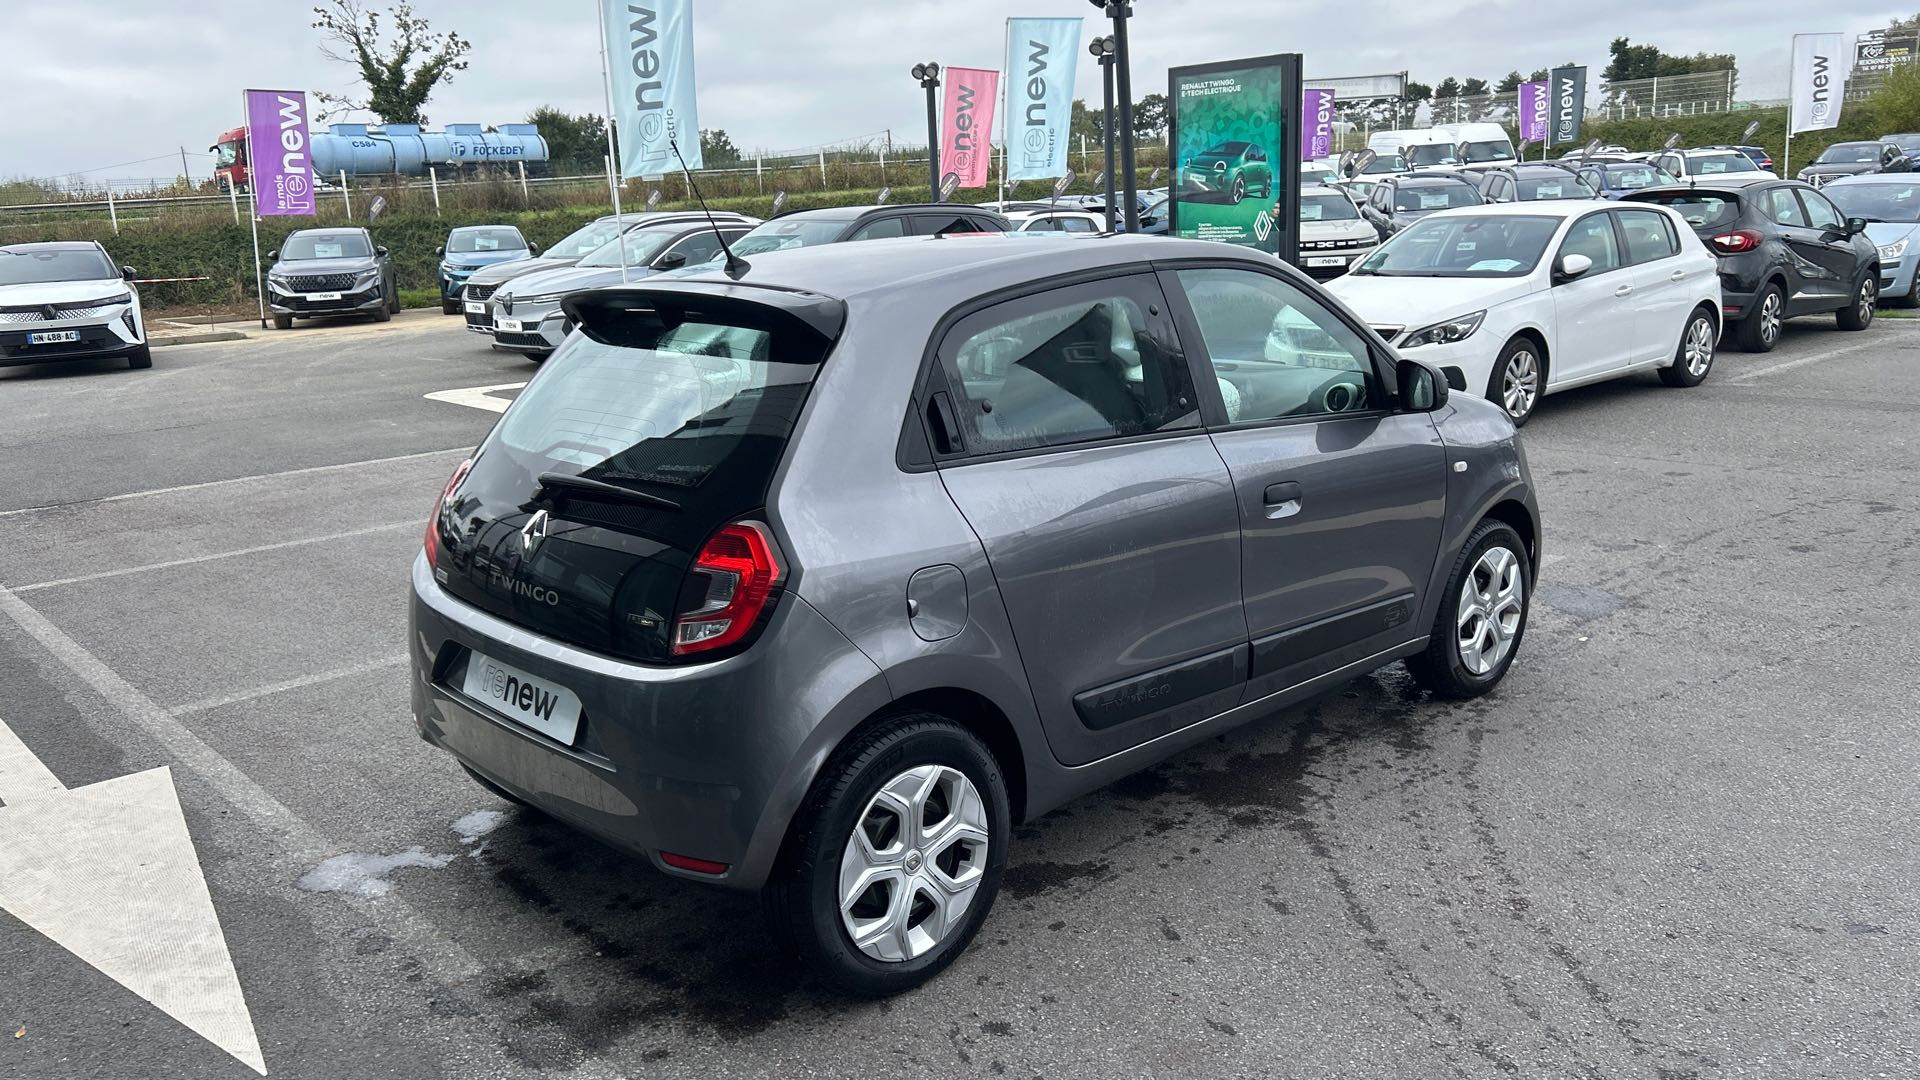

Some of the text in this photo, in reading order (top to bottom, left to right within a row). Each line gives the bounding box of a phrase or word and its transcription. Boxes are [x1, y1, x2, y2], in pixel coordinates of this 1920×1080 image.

[628, 4, 667, 162] renew
[1023, 40, 1049, 168] renew
[1181, 79, 1235, 90] RENAULT TWINGO
[1181, 88, 1203, 97] E-TECH
[1558, 78, 1574, 141] renew
[1811, 55, 1828, 125] renew
[954, 84, 975, 181] renew
[1316, 92, 1332, 157] renew
[1534, 84, 1547, 139] renew
[277, 95, 310, 209] renew
[352, 140, 377, 148] C584
[472, 145, 525, 156] FOCKEDEY
[1047, 128, 1055, 167] electric
[274, 174, 284, 198] mois
[491, 572, 560, 606] TWINGO
[482, 664, 559, 721] renew
